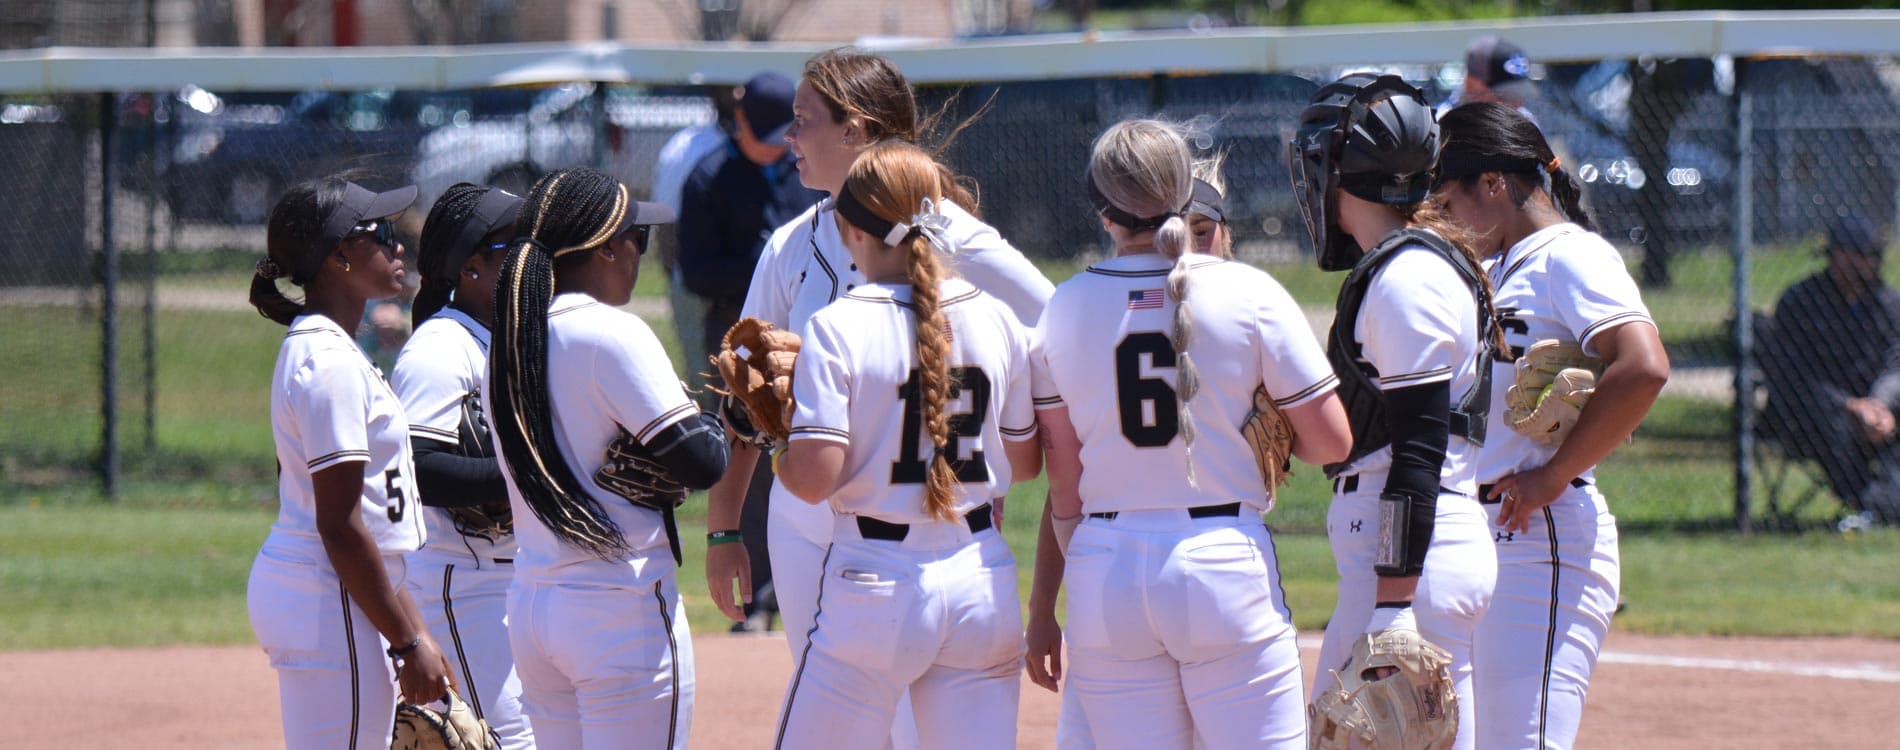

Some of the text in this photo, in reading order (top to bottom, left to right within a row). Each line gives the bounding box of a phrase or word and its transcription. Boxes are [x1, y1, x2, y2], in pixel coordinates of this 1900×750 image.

[889, 366, 991, 484] 12
[1115, 332, 1179, 449] 6
[385, 467, 405, 523] 5
